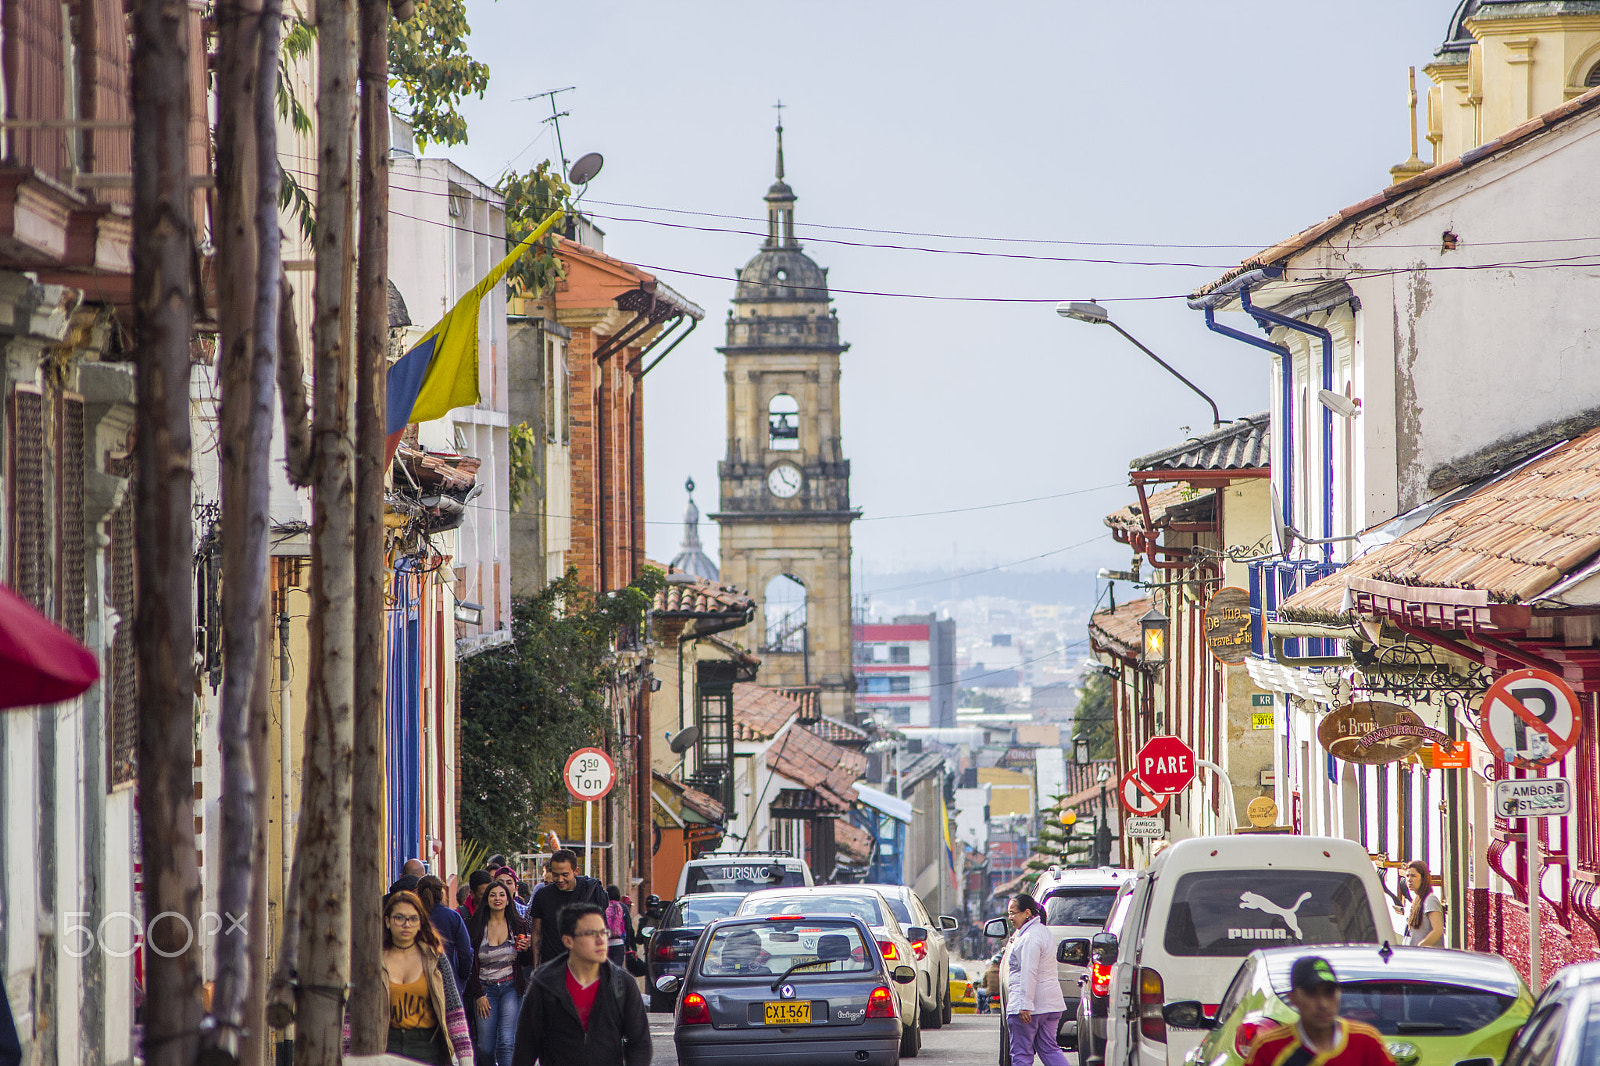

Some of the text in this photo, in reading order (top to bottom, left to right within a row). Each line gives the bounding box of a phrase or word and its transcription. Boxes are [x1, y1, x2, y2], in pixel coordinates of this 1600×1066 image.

[1206, 606, 1242, 631] De Una
[1209, 634, 1235, 647] travel
[1259, 695, 1271, 705] KR
[1399, 714, 1412, 724] LA
[1145, 755, 1188, 775] PARE
[575, 775, 602, 789] Ton
[1512, 785, 1554, 797] AMBOS
[1227, 928, 1287, 940] PUMA
